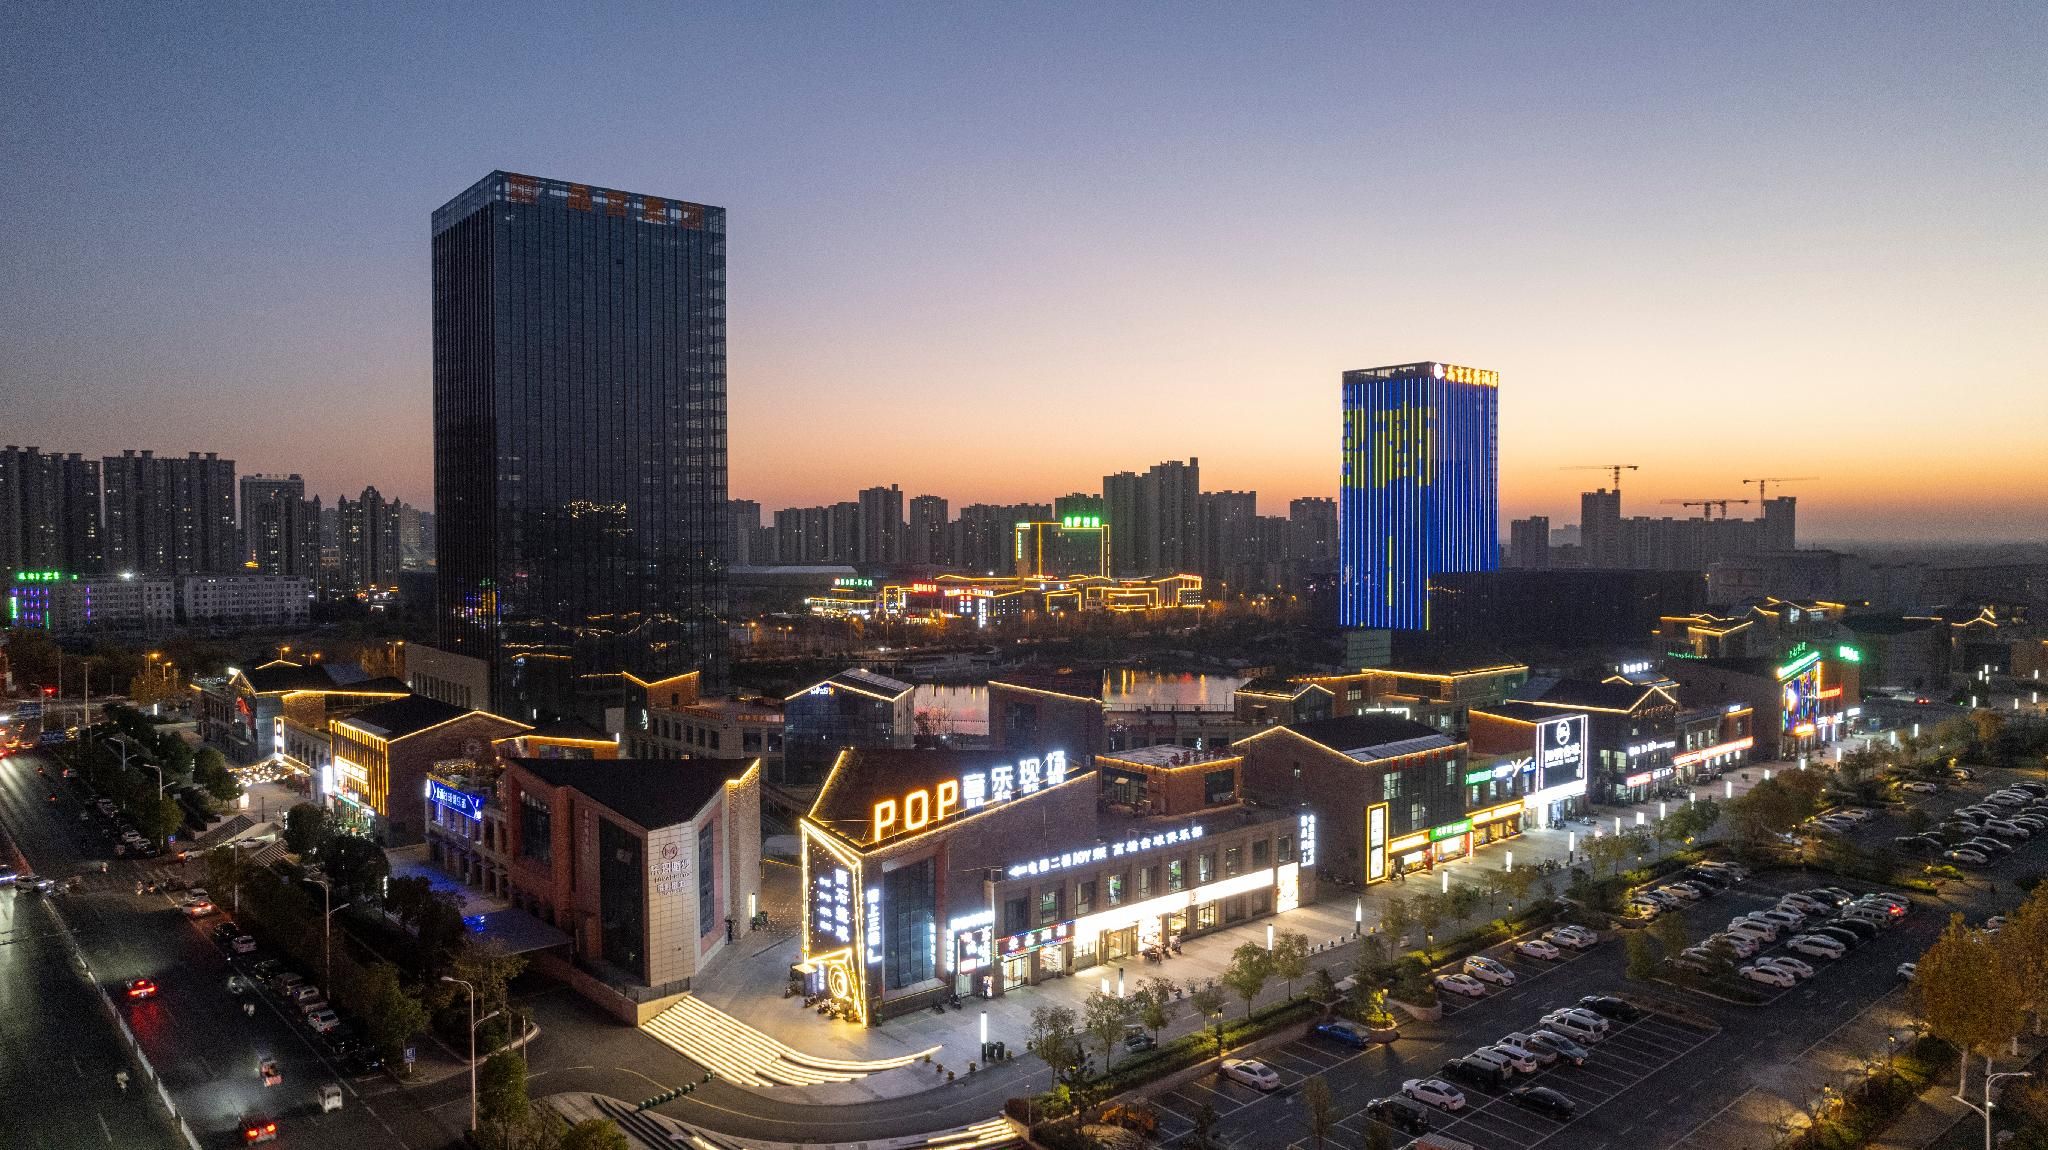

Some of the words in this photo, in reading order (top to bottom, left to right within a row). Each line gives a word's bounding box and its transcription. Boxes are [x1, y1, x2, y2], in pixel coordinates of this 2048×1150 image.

[874, 779, 958, 842] POP
[963, 750, 1066, 800] 音乐现场
